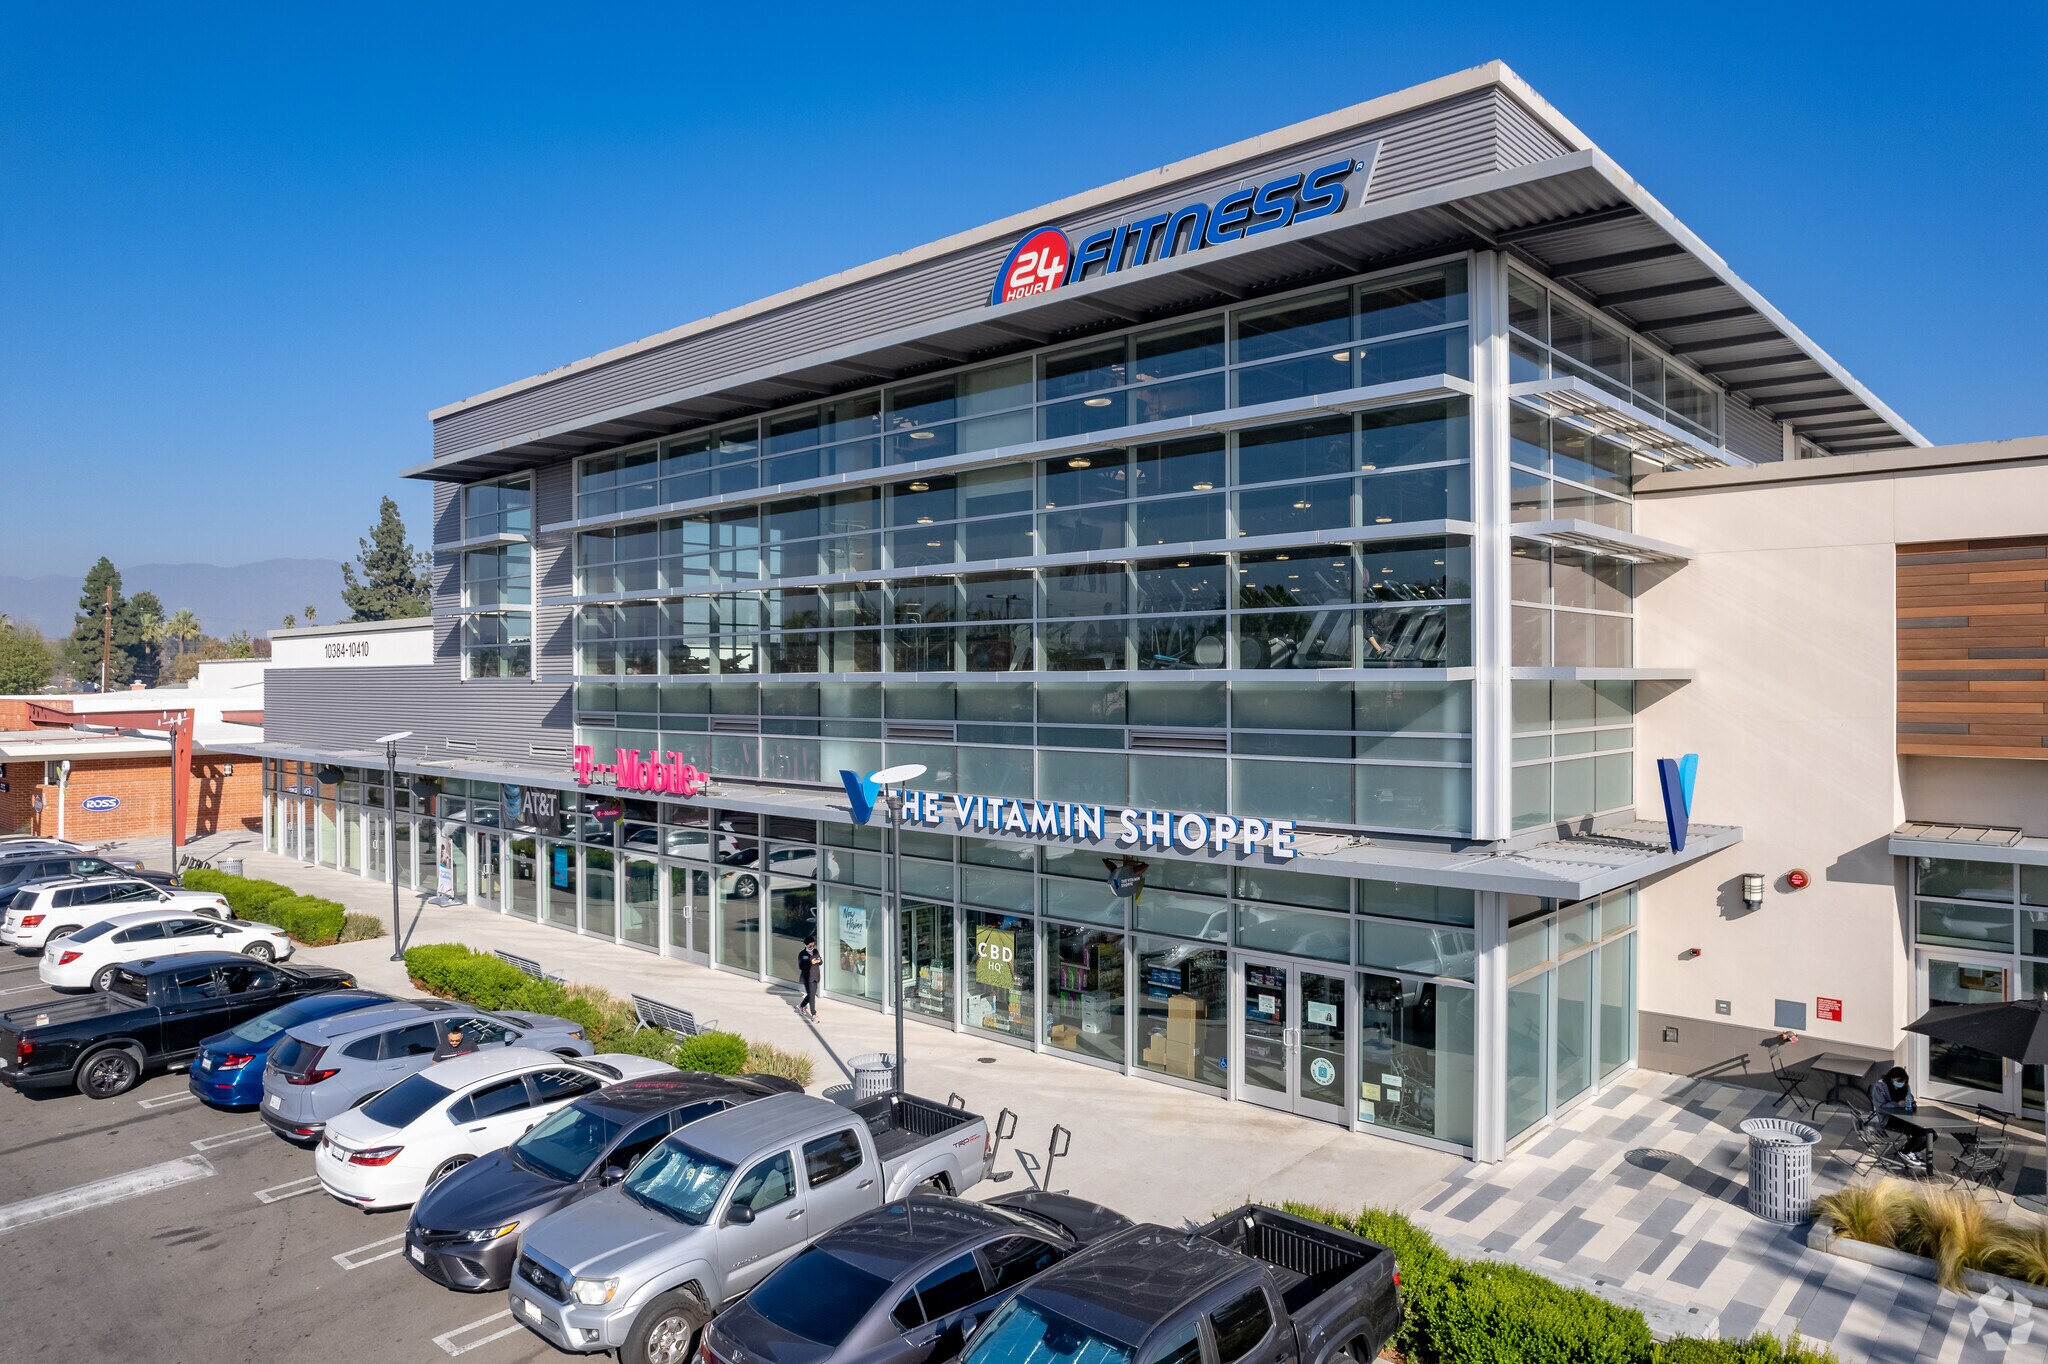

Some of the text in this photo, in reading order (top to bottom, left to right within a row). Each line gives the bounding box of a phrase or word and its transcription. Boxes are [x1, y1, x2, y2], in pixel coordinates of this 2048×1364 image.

[1010, 247, 1065, 291] 24
[1006, 282, 1044, 301] HOUR
[325, 641, 369, 658] 10384-10410
[86, 799, 117, 808] ROSS
[523, 791, 557, 817] AT&T
[953, 795, 1104, 840] VITAMIN
[1120, 808, 1298, 858] SHOPPE
[843, 906, 856, 919] Now
[978, 942, 1013, 962] CBD
[988, 961, 1001, 973] HQ
